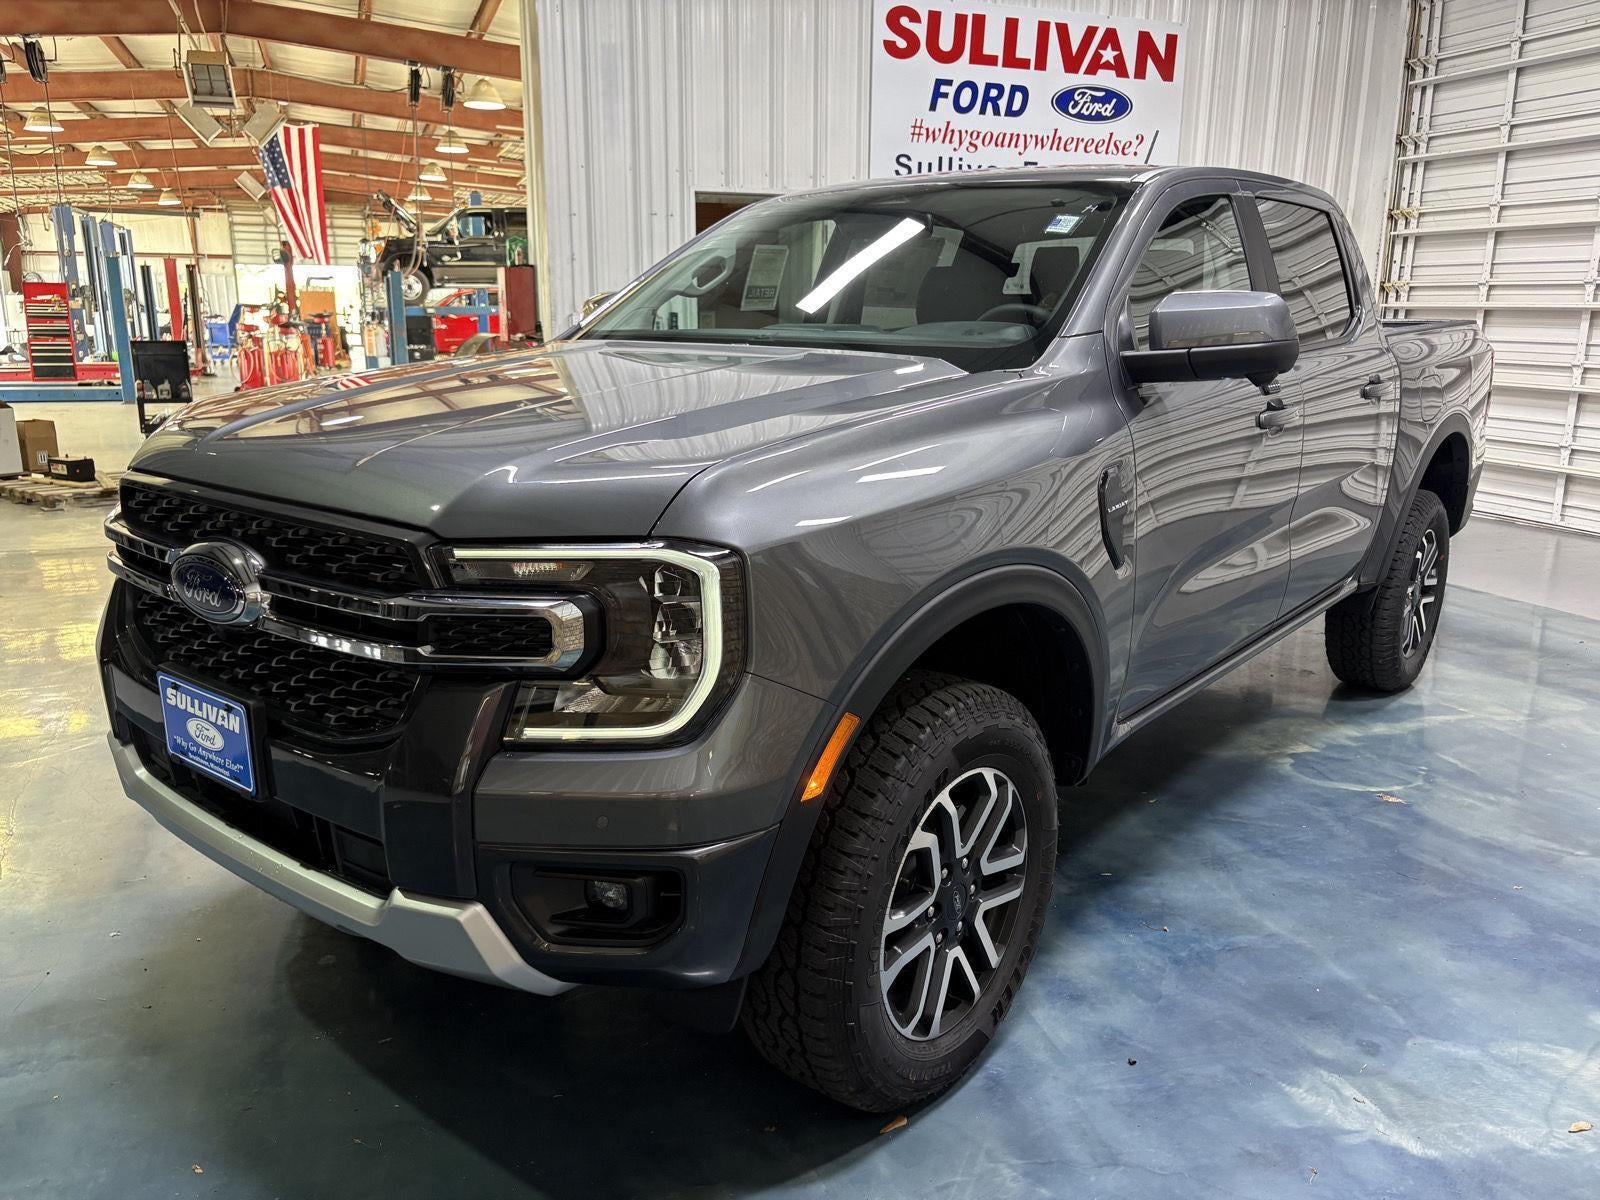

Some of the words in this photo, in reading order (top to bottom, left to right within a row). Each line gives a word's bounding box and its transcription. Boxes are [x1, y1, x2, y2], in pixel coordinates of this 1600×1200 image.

[882, 5, 1178, 82] SULLIVAN
[928, 78, 1030, 118] FORD
[910, 118, 1144, 157] #whygoanywhereelse?
[895, 154, 998, 176] Sulli
[184, 570, 223, 608] Ford
[166, 687, 240, 735] SULLIVAN
[194, 723, 217, 746] Ford
